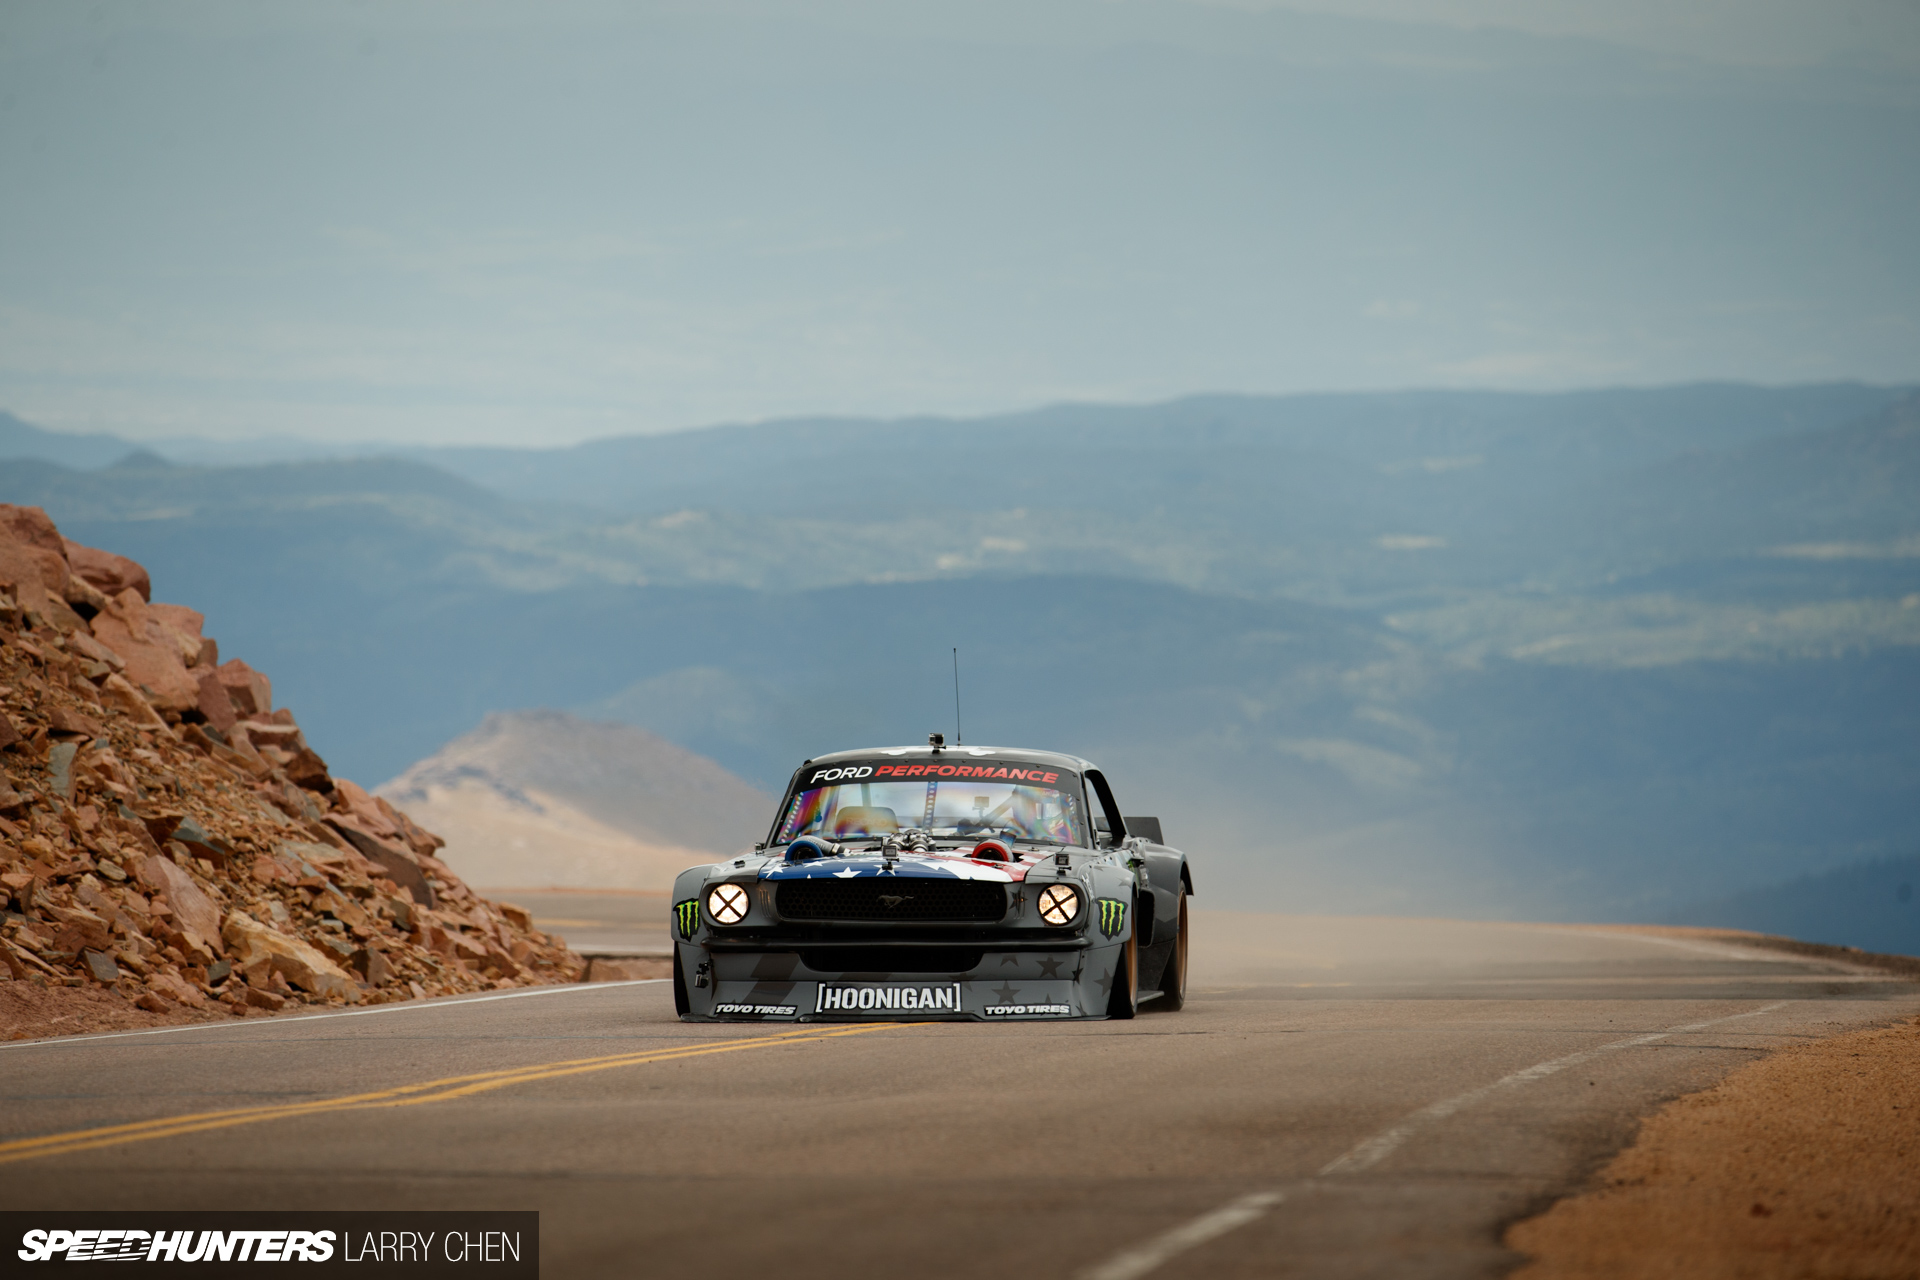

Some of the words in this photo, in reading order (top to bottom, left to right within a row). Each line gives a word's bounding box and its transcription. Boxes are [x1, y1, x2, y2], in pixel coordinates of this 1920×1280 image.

[810, 766, 873, 784] FORD
[874, 764, 1060, 784] PERFORMANCE
[715, 1004, 754, 1014] TOYO
[754, 1005, 796, 1015] TIRES
[985, 1005, 1026, 1015] TOYO
[1026, 1004, 1070, 1014] TIRES
